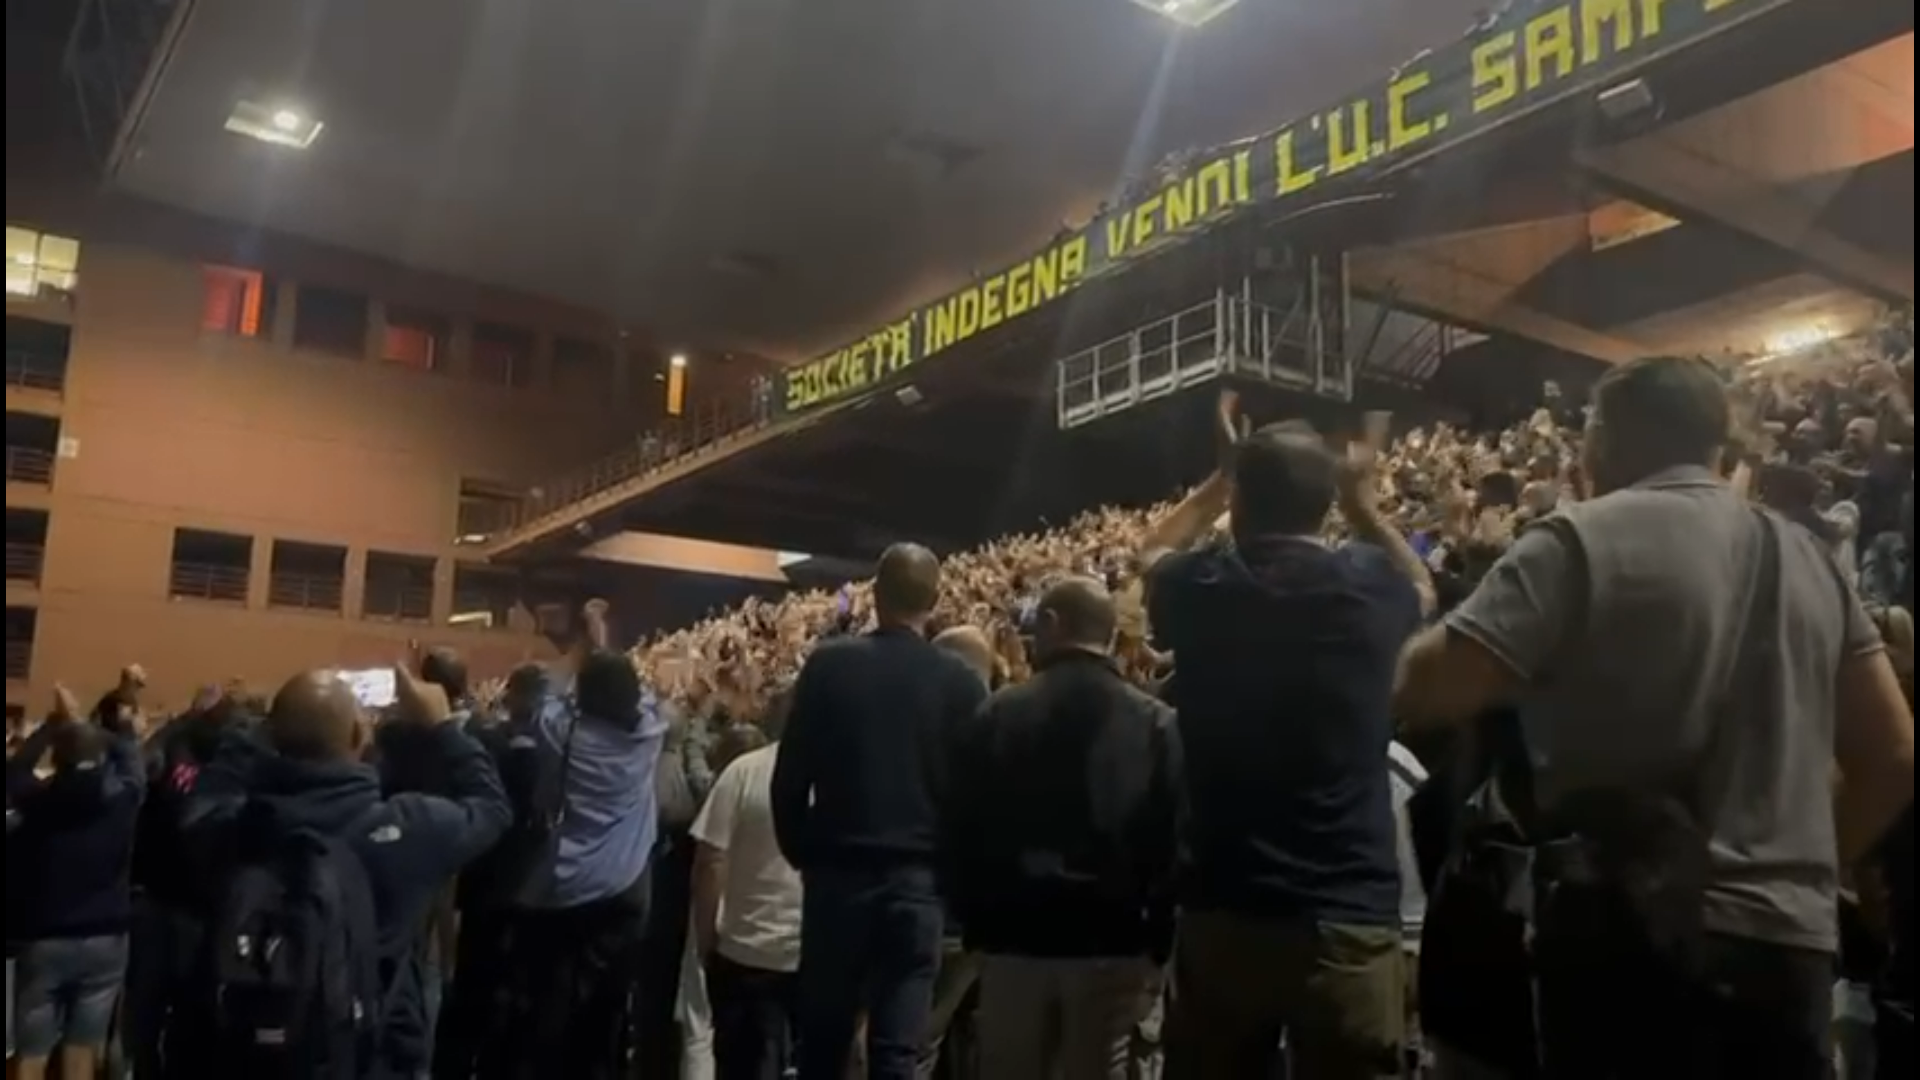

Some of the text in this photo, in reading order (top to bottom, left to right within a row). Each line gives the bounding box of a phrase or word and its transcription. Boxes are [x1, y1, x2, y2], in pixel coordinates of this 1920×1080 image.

[923, 235, 1087, 356] INDEGNA
[1275, 71, 1449, 197] L'U.C.
[1471, 0, 1734, 113] SAM
